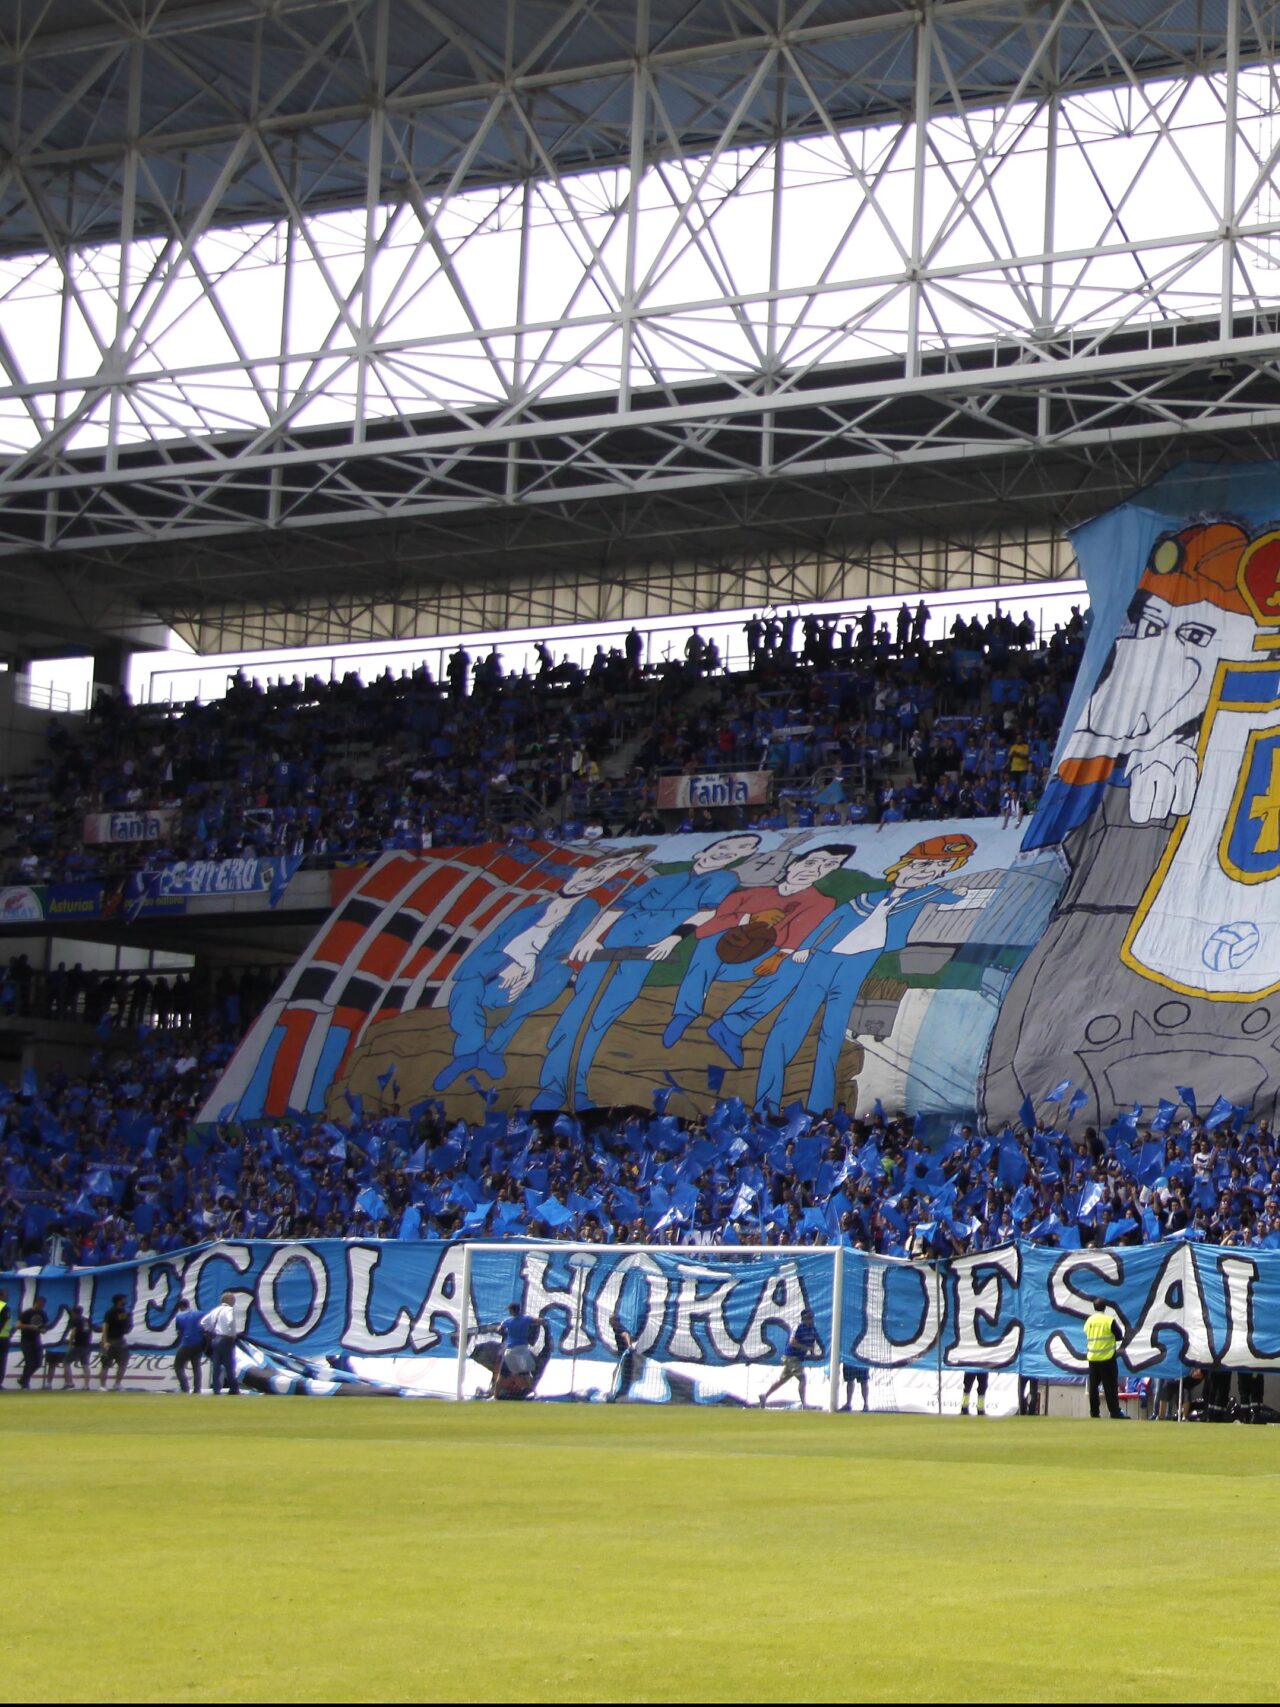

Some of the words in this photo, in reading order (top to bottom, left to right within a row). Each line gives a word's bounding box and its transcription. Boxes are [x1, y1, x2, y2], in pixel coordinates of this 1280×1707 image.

[689, 776, 749, 805] Fanta
[110, 813, 161, 841] Fanta
[49, 897, 94, 913] Asturias
[340, 1243, 484, 1353] LA
[520, 1251, 825, 1361] HORA
[851, 1243, 1023, 1368] DE
